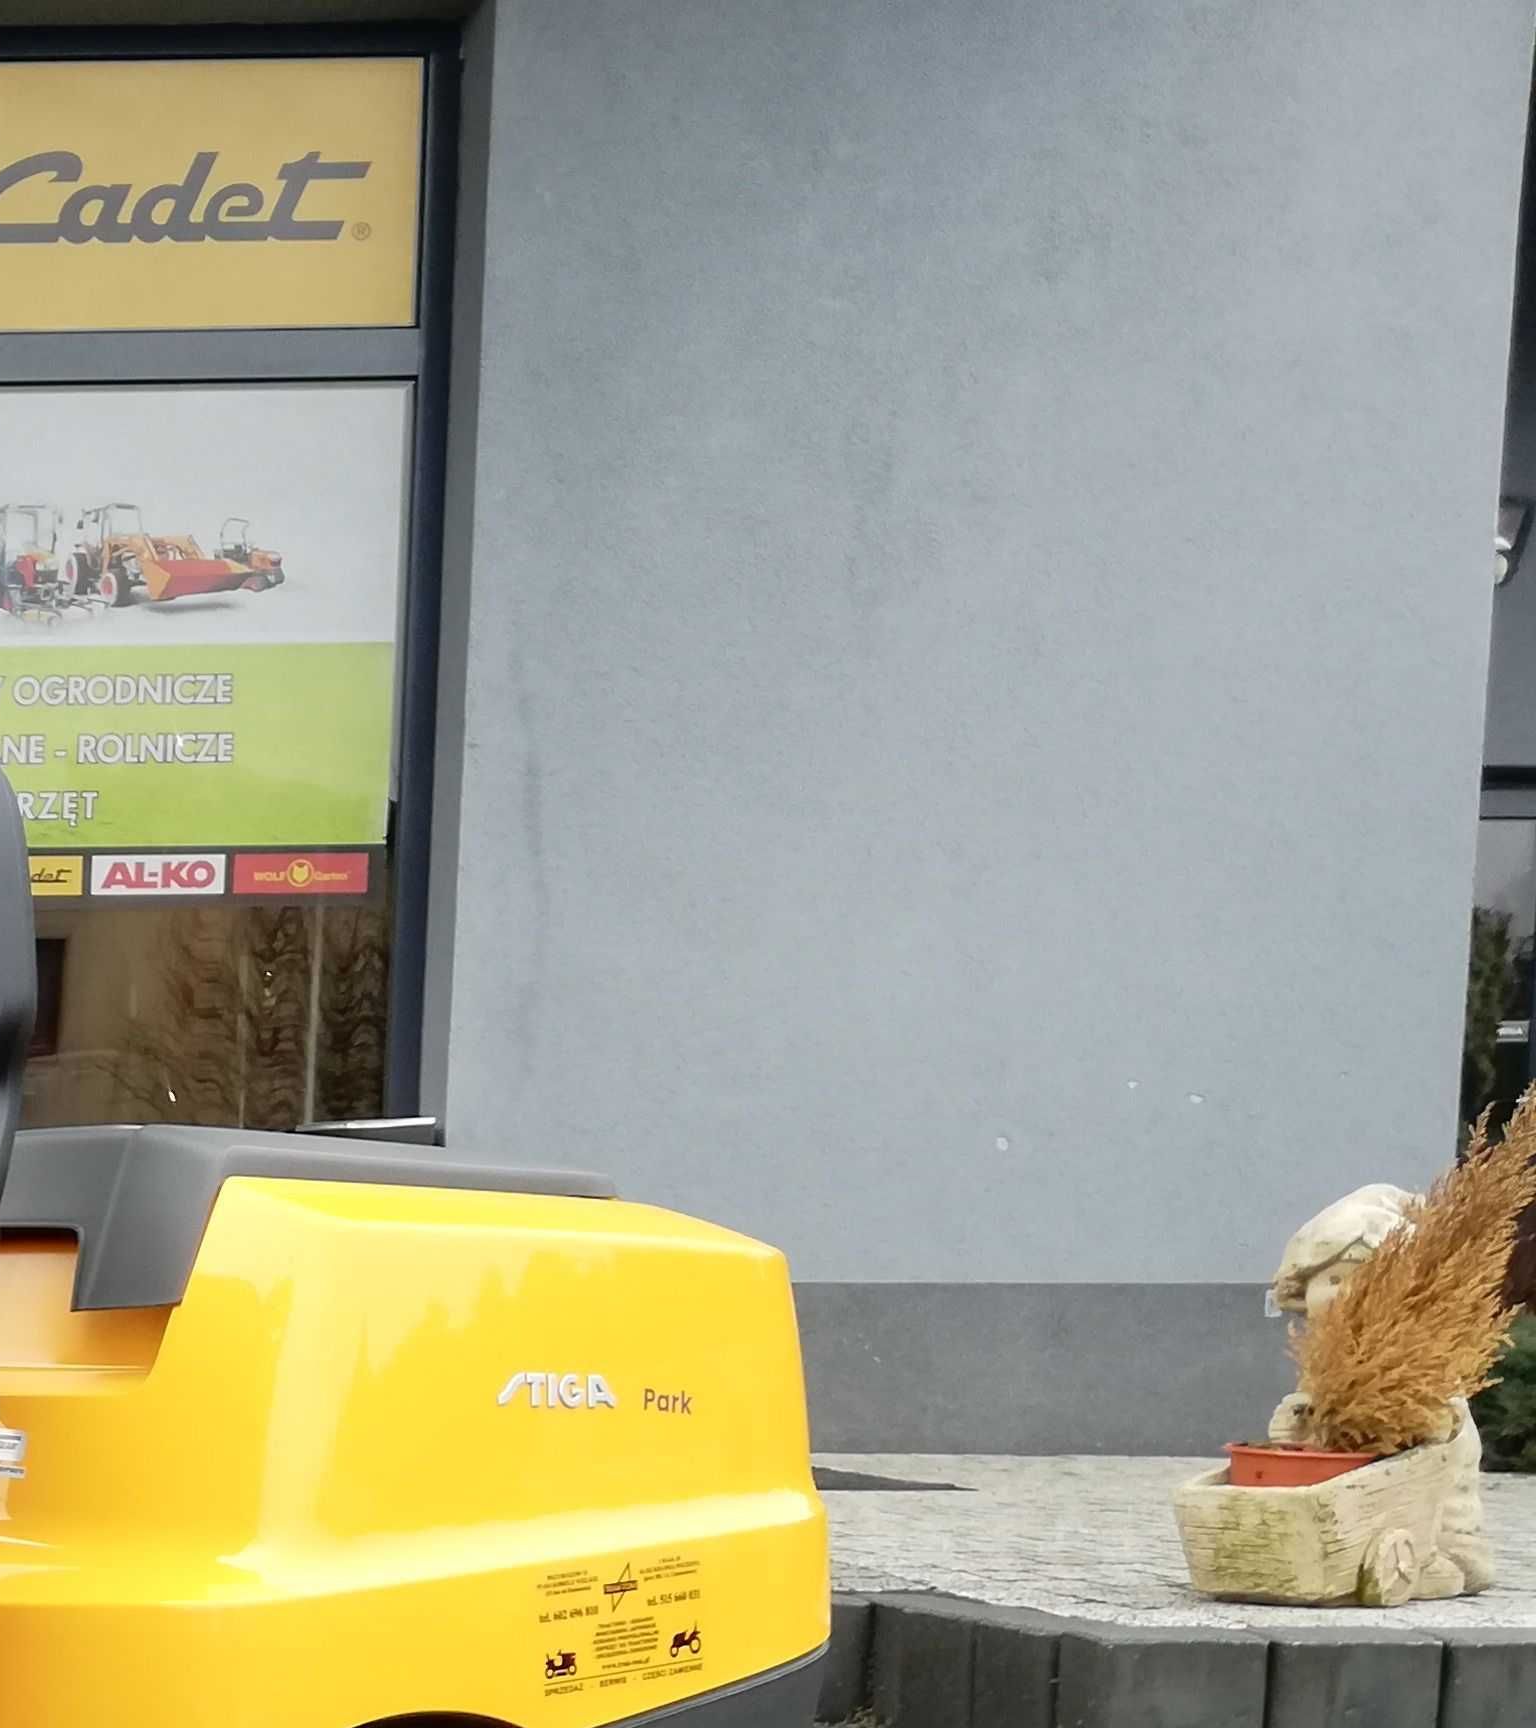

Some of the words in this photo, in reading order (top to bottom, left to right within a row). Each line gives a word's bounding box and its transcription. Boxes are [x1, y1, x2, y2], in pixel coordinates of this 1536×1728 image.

[13, 674, 233, 706] OGRODNICZE
[76, 733, 235, 765] ROLNICZE
[16, 791, 99, 827] RZĘT
[101, 860, 216, 889] AL-KO
[496, 1371, 616, 1409] STIGA
[642, 1387, 693, 1415] Park
